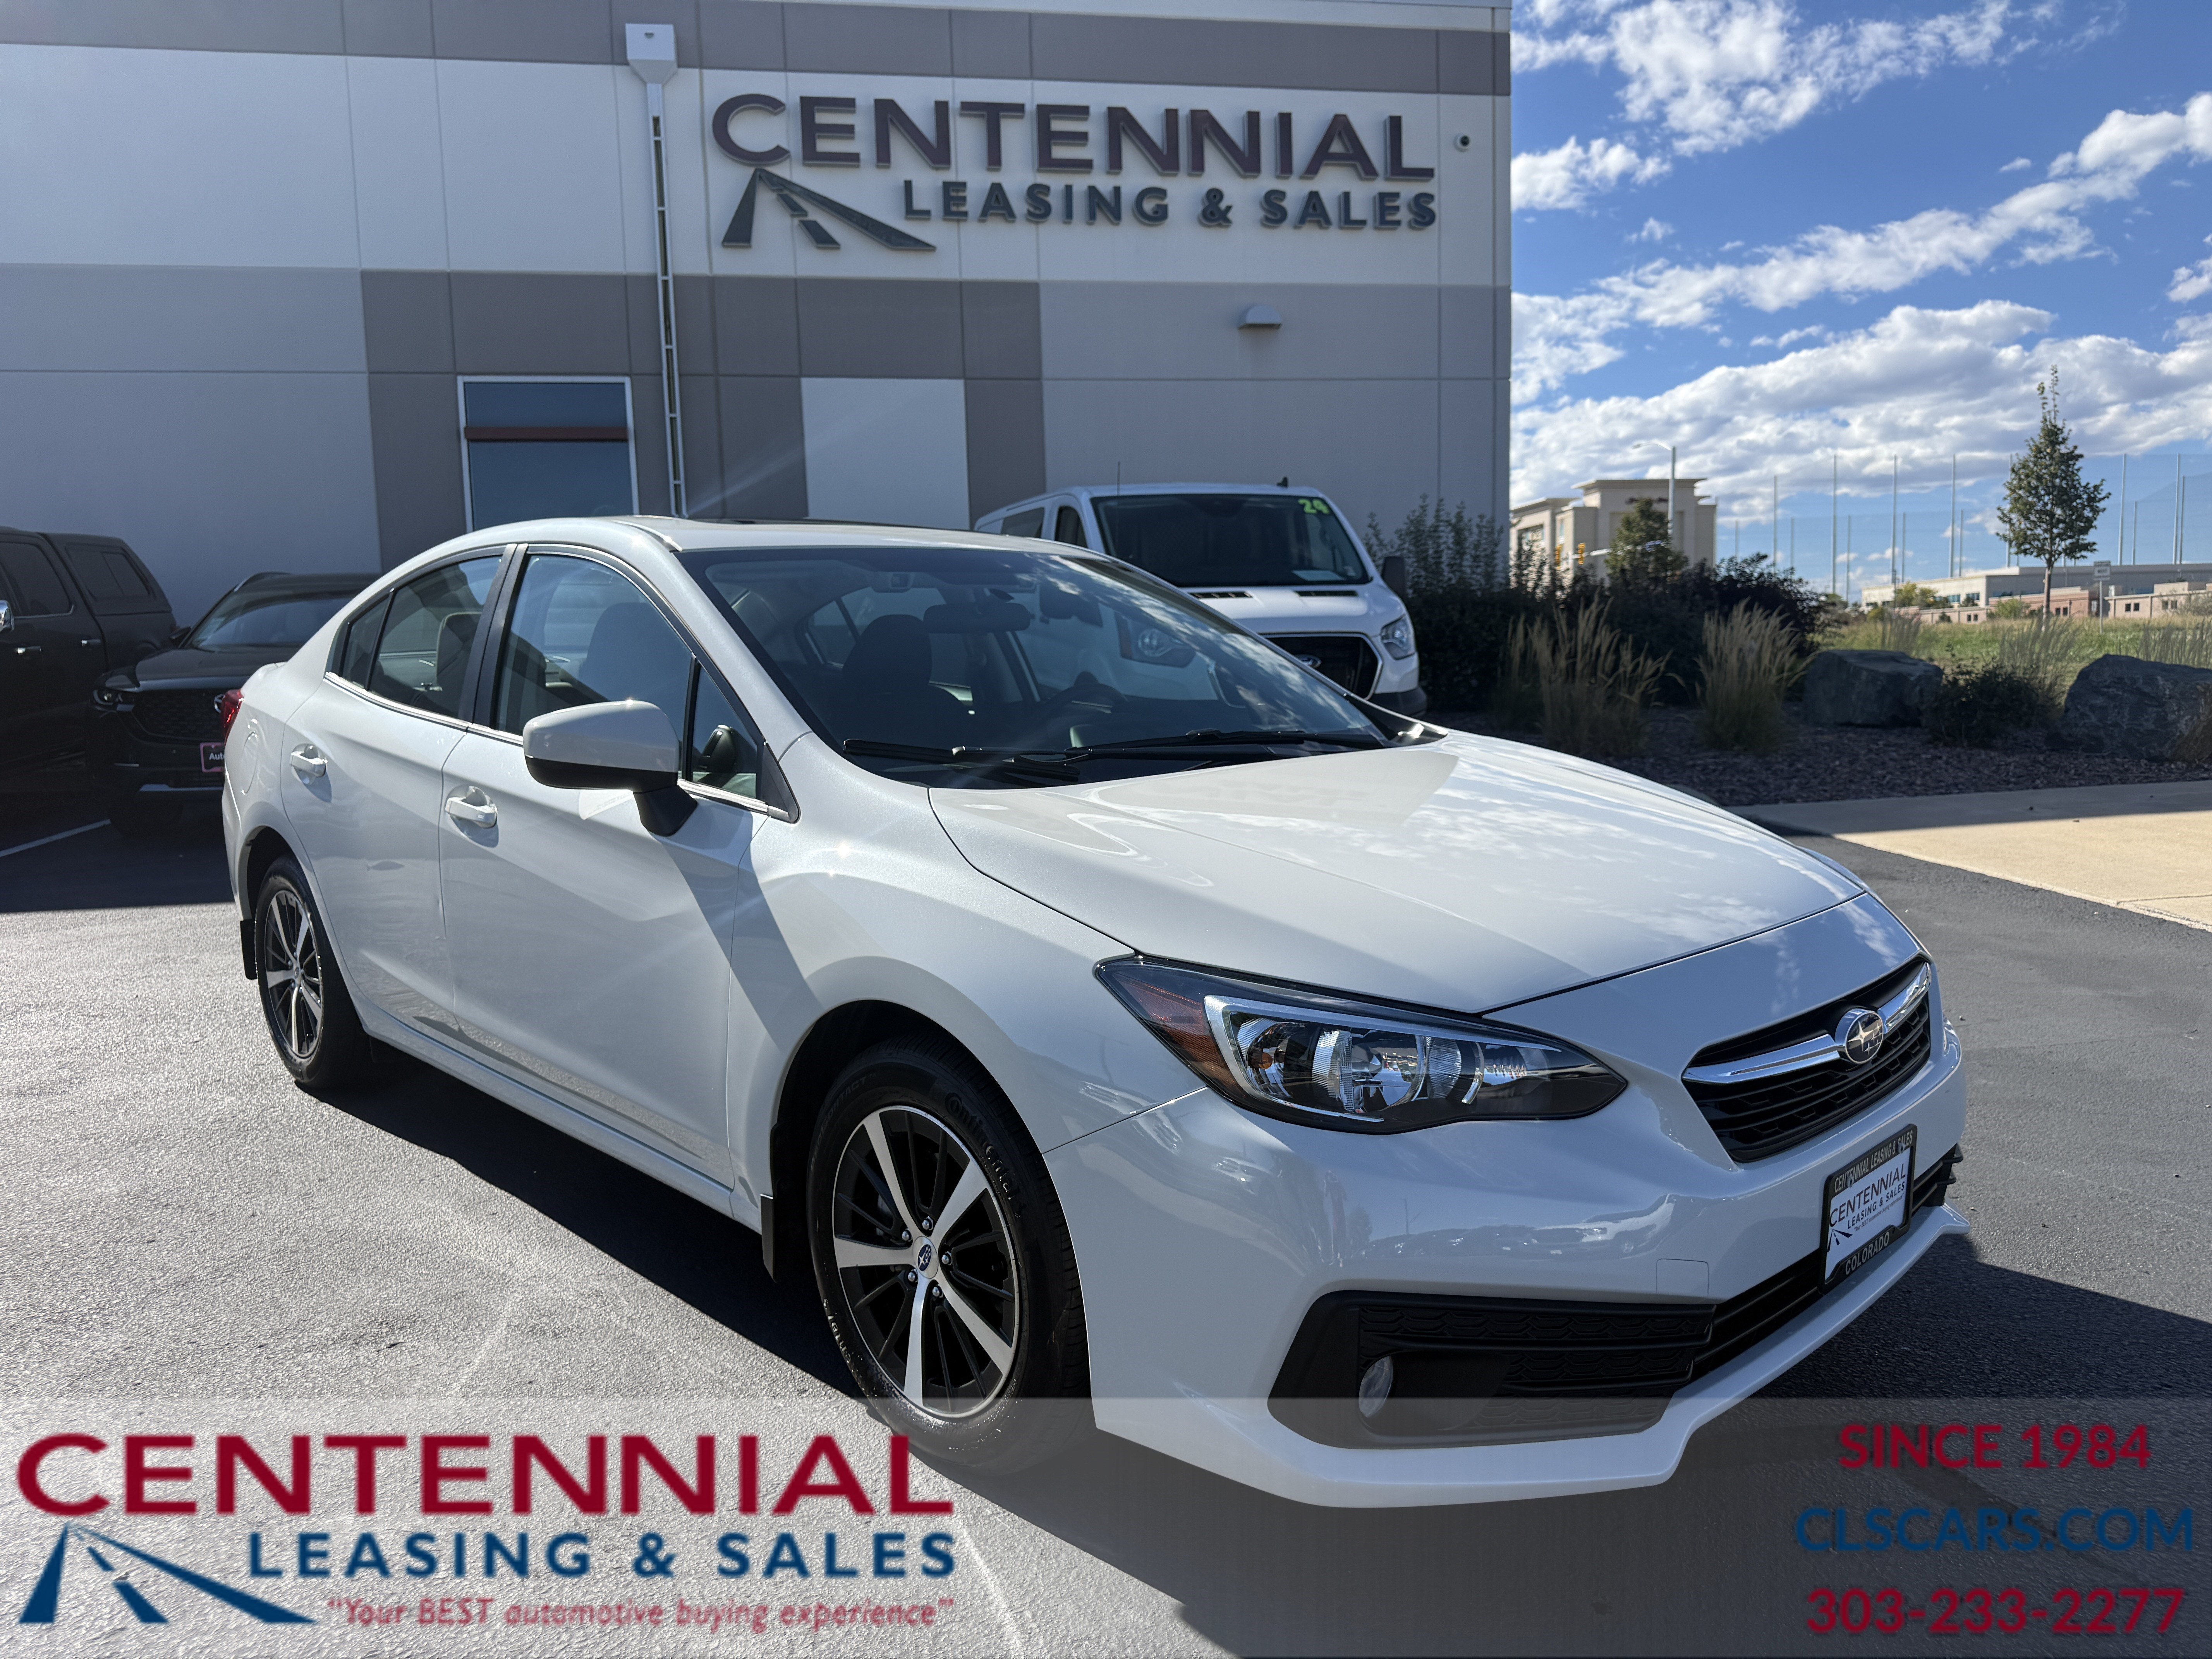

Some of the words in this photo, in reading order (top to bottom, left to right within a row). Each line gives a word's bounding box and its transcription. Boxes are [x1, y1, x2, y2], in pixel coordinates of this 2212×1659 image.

[712, 93, 1435, 180] CENTENNIAL
[904, 179, 1168, 226] LEASING
[1199, 187, 1233, 227] &
[1261, 189, 1436, 230] SALES
[209, 752, 225, 761] Aut
[944, 1092, 1021, 1200] Continental
[1870, 1143, 1892, 1169] LEASING
[1892, 1140, 1896, 1154] &
[1830, 1163, 1906, 1227] CENTENNIAL
[1848, 1201, 1877, 1229] LEASING
[1879, 1197, 1883, 1207] &
[1886, 1181, 1905, 1202] SALES
[1846, 1232, 1889, 1275] COLORADO
